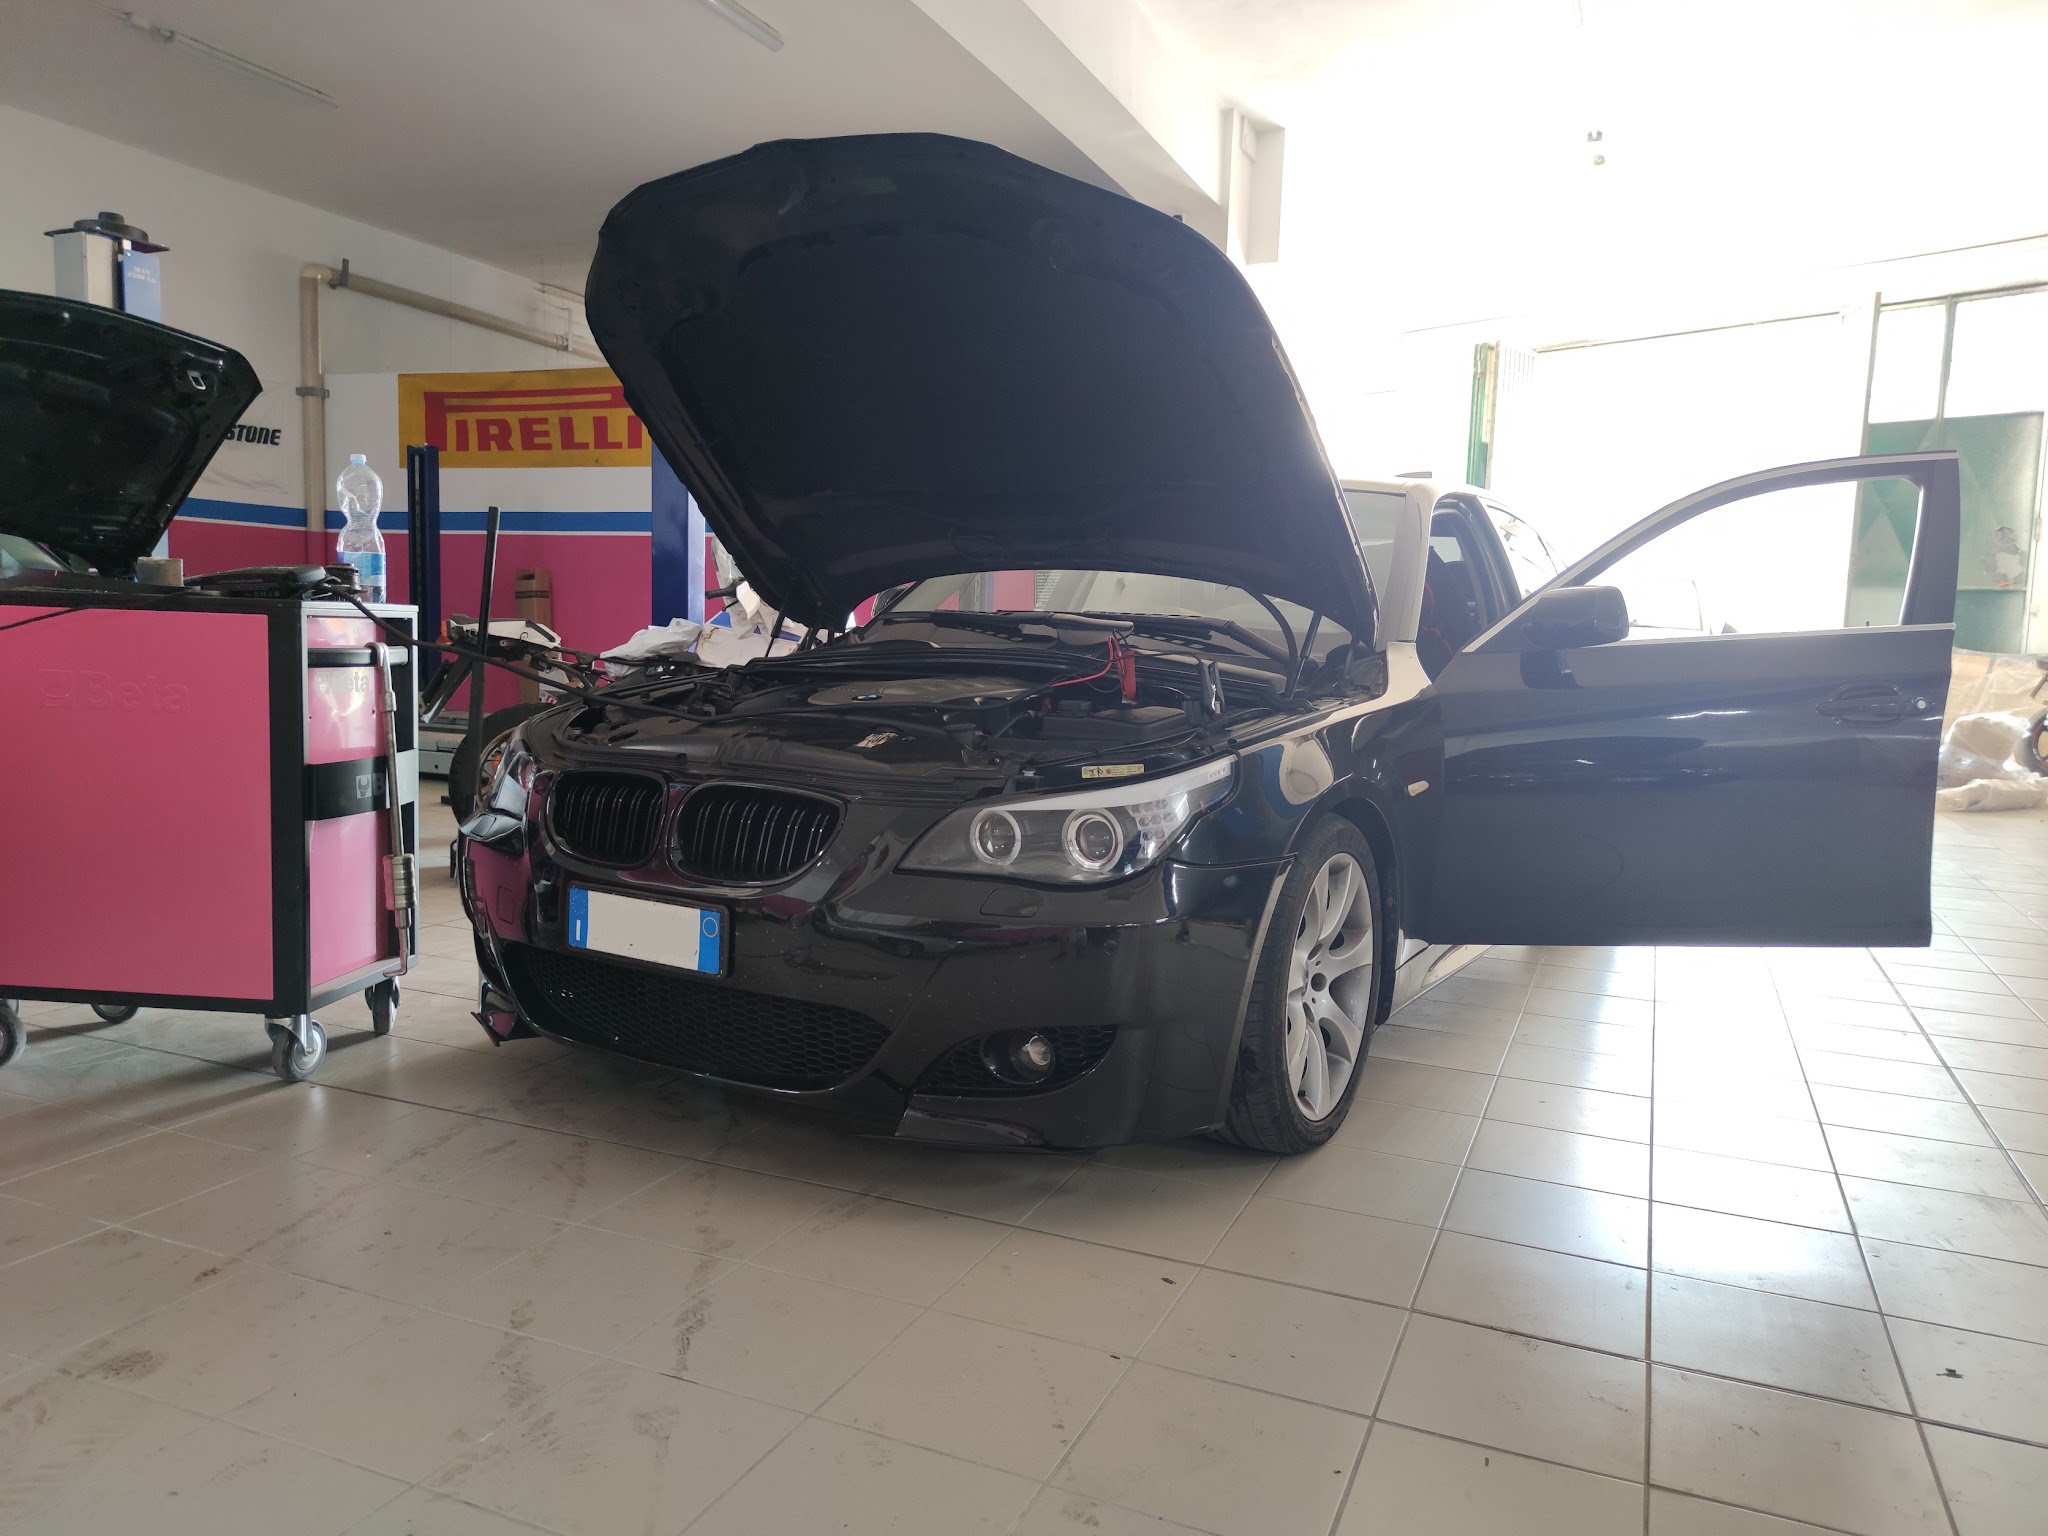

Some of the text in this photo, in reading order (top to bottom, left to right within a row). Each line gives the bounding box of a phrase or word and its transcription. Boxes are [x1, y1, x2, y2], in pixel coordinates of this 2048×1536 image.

[424, 386, 643, 452] PIRELLI
[80, 671, 191, 712] Beta
[575, 919, 581, 941] I
